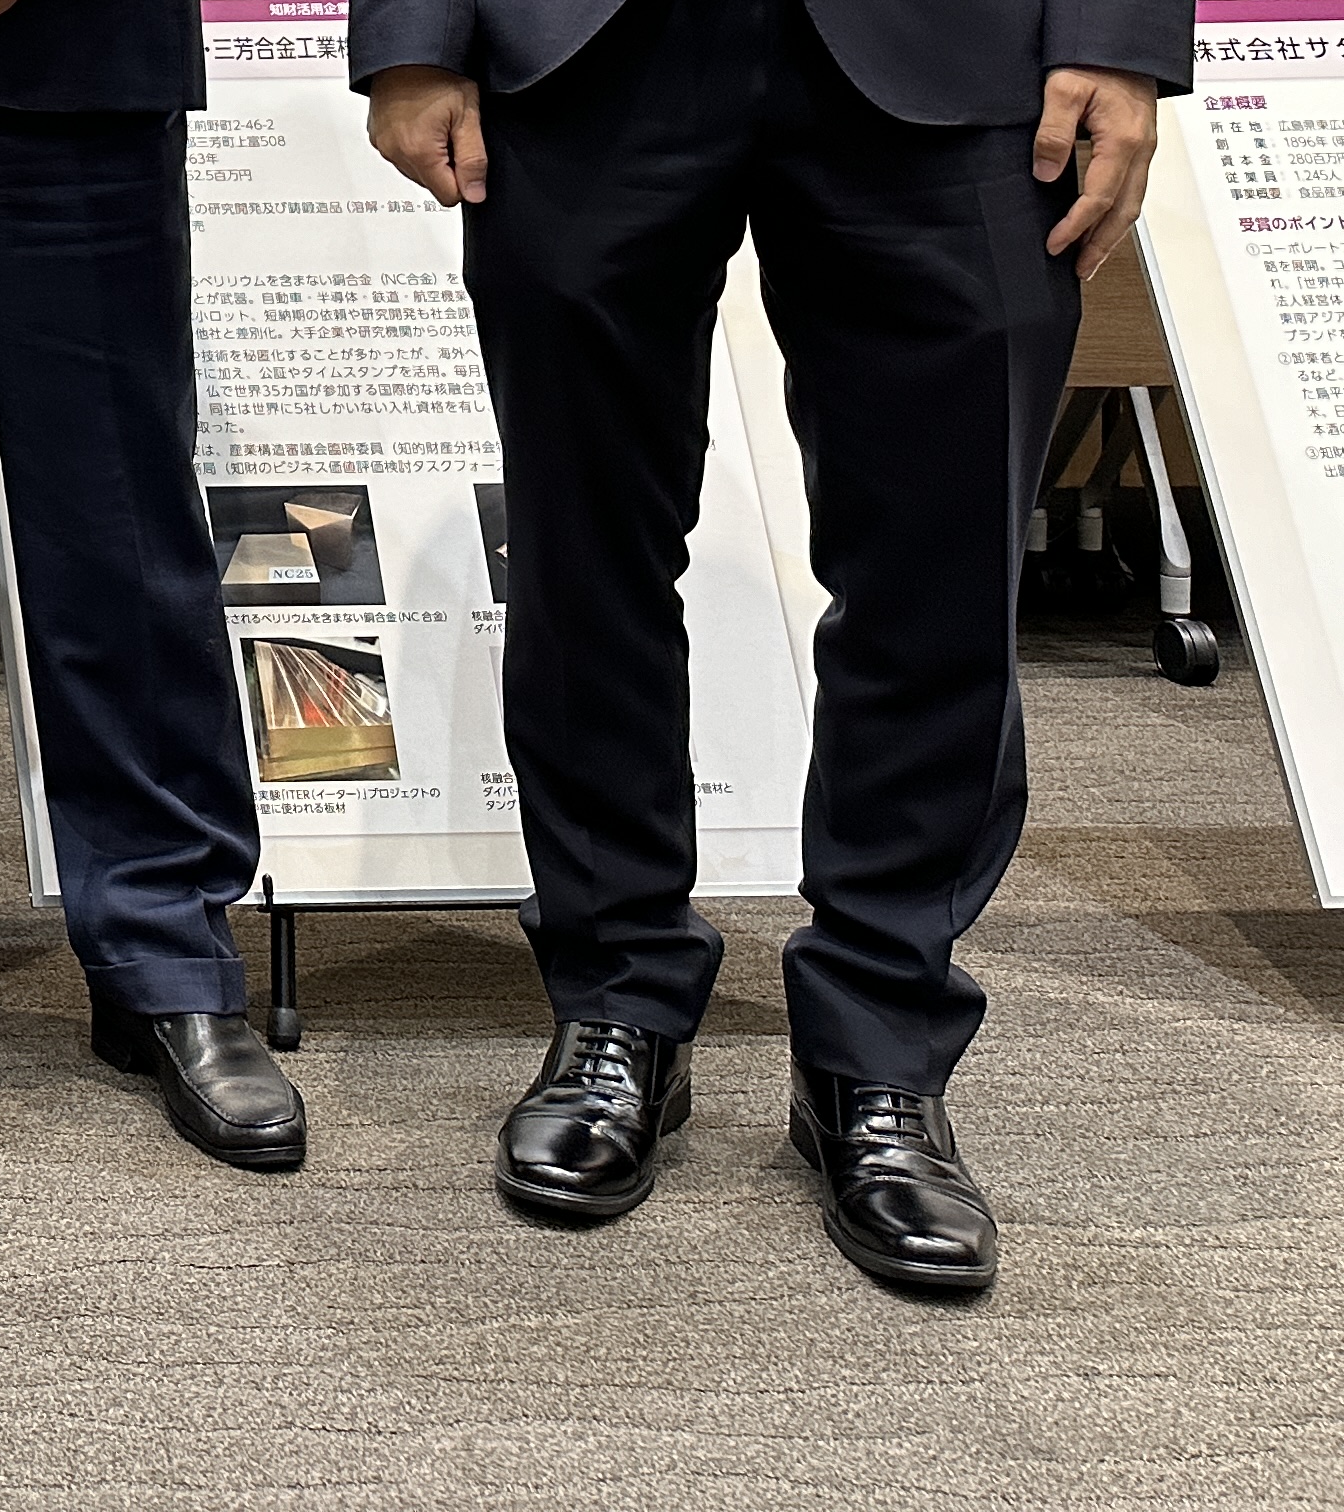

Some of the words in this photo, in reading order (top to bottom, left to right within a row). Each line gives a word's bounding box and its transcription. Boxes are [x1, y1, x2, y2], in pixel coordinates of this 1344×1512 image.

[1204, 95, 1267, 110] 企業概要
[273, 569, 313, 579] NC25
